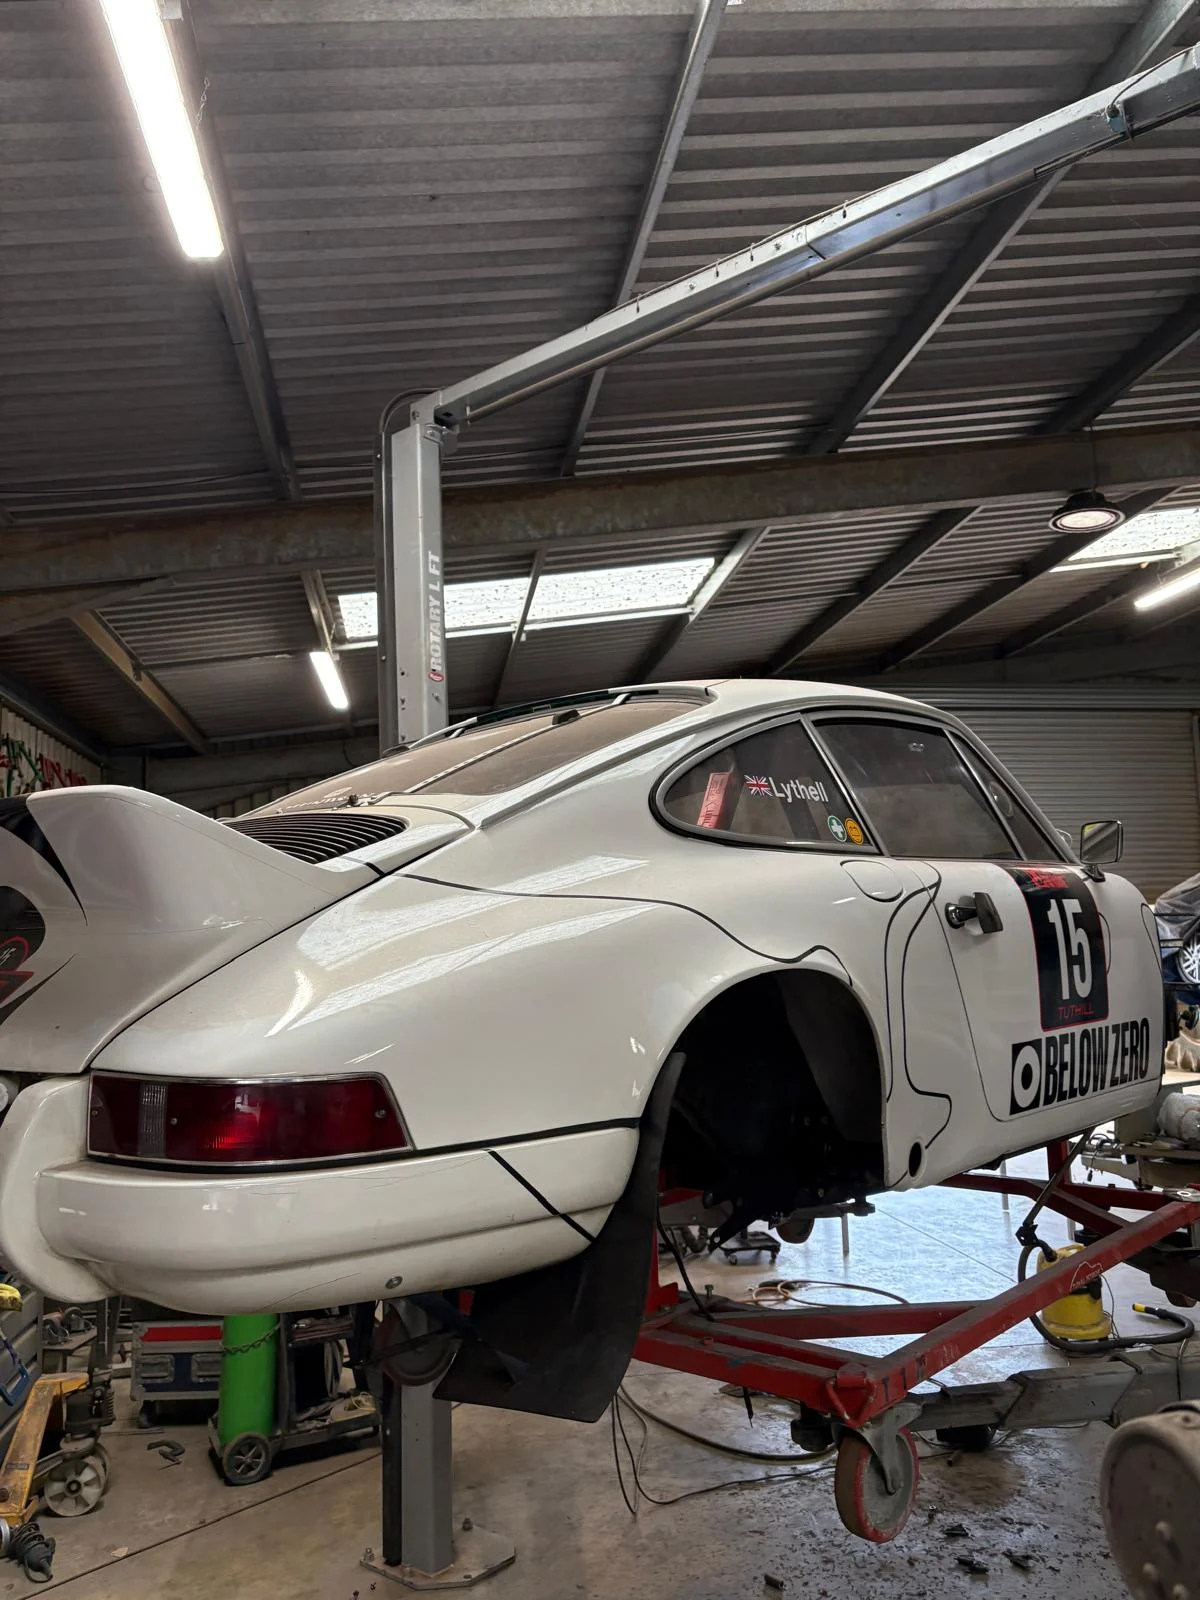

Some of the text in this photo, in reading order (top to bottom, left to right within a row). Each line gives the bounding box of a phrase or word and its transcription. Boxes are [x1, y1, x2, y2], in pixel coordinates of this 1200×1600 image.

[429, 594, 442, 670] ROTARY
[769, 777, 829, 803] Lythell
[1048, 898, 1093, 1000] 15
[1058, 1003, 1095, 1020] TUTHILL
[1042, 1017, 1150, 1107] BELOW ZERO
